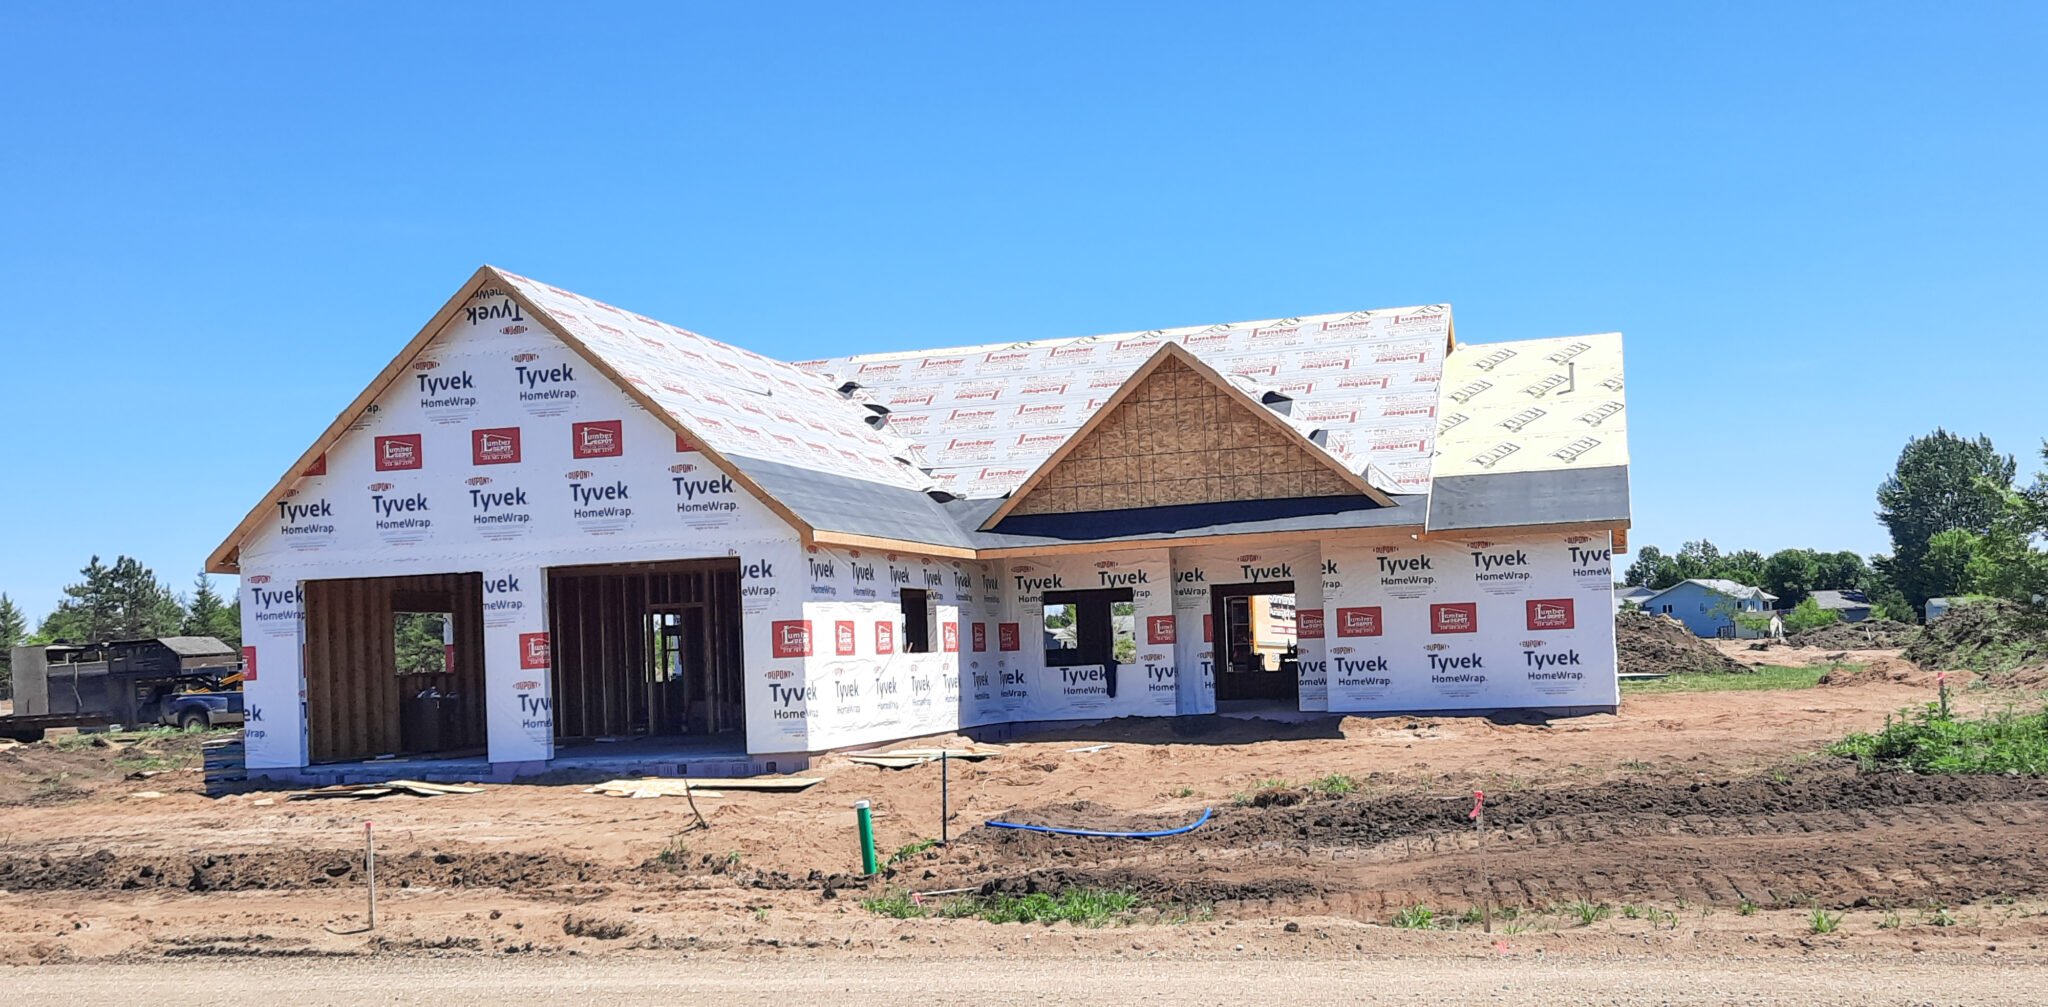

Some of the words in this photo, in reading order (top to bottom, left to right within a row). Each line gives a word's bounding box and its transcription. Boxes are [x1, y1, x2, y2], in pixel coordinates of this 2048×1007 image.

[466, 299, 524, 326] Tyvek
[514, 354, 537, 363] DUPONT
[984, 353, 1030, 363] Lumber
[1049, 347, 1094, 358] Lumber
[416, 361, 437, 370] DUPONT
[858, 364, 902, 374] Lumber
[920, 358, 964, 369] Lumber
[515, 363, 574, 389] Tyvek
[417, 371, 474, 396] Tyvek
[519, 390, 577, 402] HomeWrap
[420, 396, 477, 410] HomeWrap
[949, 409, 996, 421] Lumber
[1016, 404, 1065, 415] Lumber
[583, 427, 613, 445] Lumber
[1017, 433, 1067, 446] Lumber
[947, 438, 996, 450] Lumber
[670, 464, 695, 473] DUPONT
[468, 477, 491, 486] DUPONT
[568, 471, 592, 480] DUPONT
[371, 483, 392, 491] DUPONT
[672, 474, 733, 500] Tyvek
[469, 487, 527, 512] Tyvek
[569, 481, 628, 506] Tyvek
[277, 498, 332, 524] Tyvek
[372, 493, 428, 518] Tyvek
[677, 501, 737, 513] HomeWrap
[473, 511, 529, 525] HomeWrap
[574, 507, 632, 519] HomeWrap
[281, 524, 334, 536] HomeWrap
[376, 518, 431, 531] HomeWrap
[1470, 541, 1491, 549] DUPONT
[1568, 536, 1589, 544] DUPONT
[1376, 546, 1397, 554] DUPONT
[1471, 550, 1527, 571] Tyvek
[1568, 547, 1610, 567] Tyve
[808, 558, 835, 582] Tyvek
[1377, 554, 1431, 576] Tyvek
[851, 562, 875, 584] Tyvek
[889, 565, 911, 587] Tyvek
[1241, 563, 1292, 584] Tyvek
[1475, 571, 1530, 581] HomeWrap
[1573, 567, 1611, 577] HomeW
[483, 574, 520, 594] vek
[922, 568, 942, 589] Tyvek
[1015, 574, 1062, 594] Tyvek
[1098, 569, 1148, 589] Tyvek
[1381, 576, 1434, 586] HomeWrap
[742, 585, 776, 596] eWrap
[252, 585, 304, 610] Tyvek
[1019, 595, 1044, 603] Home
[1333, 646, 1353, 654] DUPONT
[1426, 643, 1447, 651] DUPONT
[1522, 640, 1544, 648] DUPONT
[1427, 653, 1482, 674] Tyvek
[1523, 649, 1580, 670] Tyvek
[1298, 660, 1327, 677] yve
[1334, 656, 1388, 677] Tyvek
[767, 670, 791, 679] DUPONT
[1431, 674, 1485, 684] HomeWrap
[1528, 671, 1582, 681] HomeWrap
[515, 680, 538, 690] DUPONT
[875, 677, 898, 699] Tyvek
[911, 674, 931, 697] Tyvek
[1338, 678, 1391, 687] HomeWrap
[835, 680, 860, 703] Tyvek
[1063, 687, 1107, 696] HomeWra
